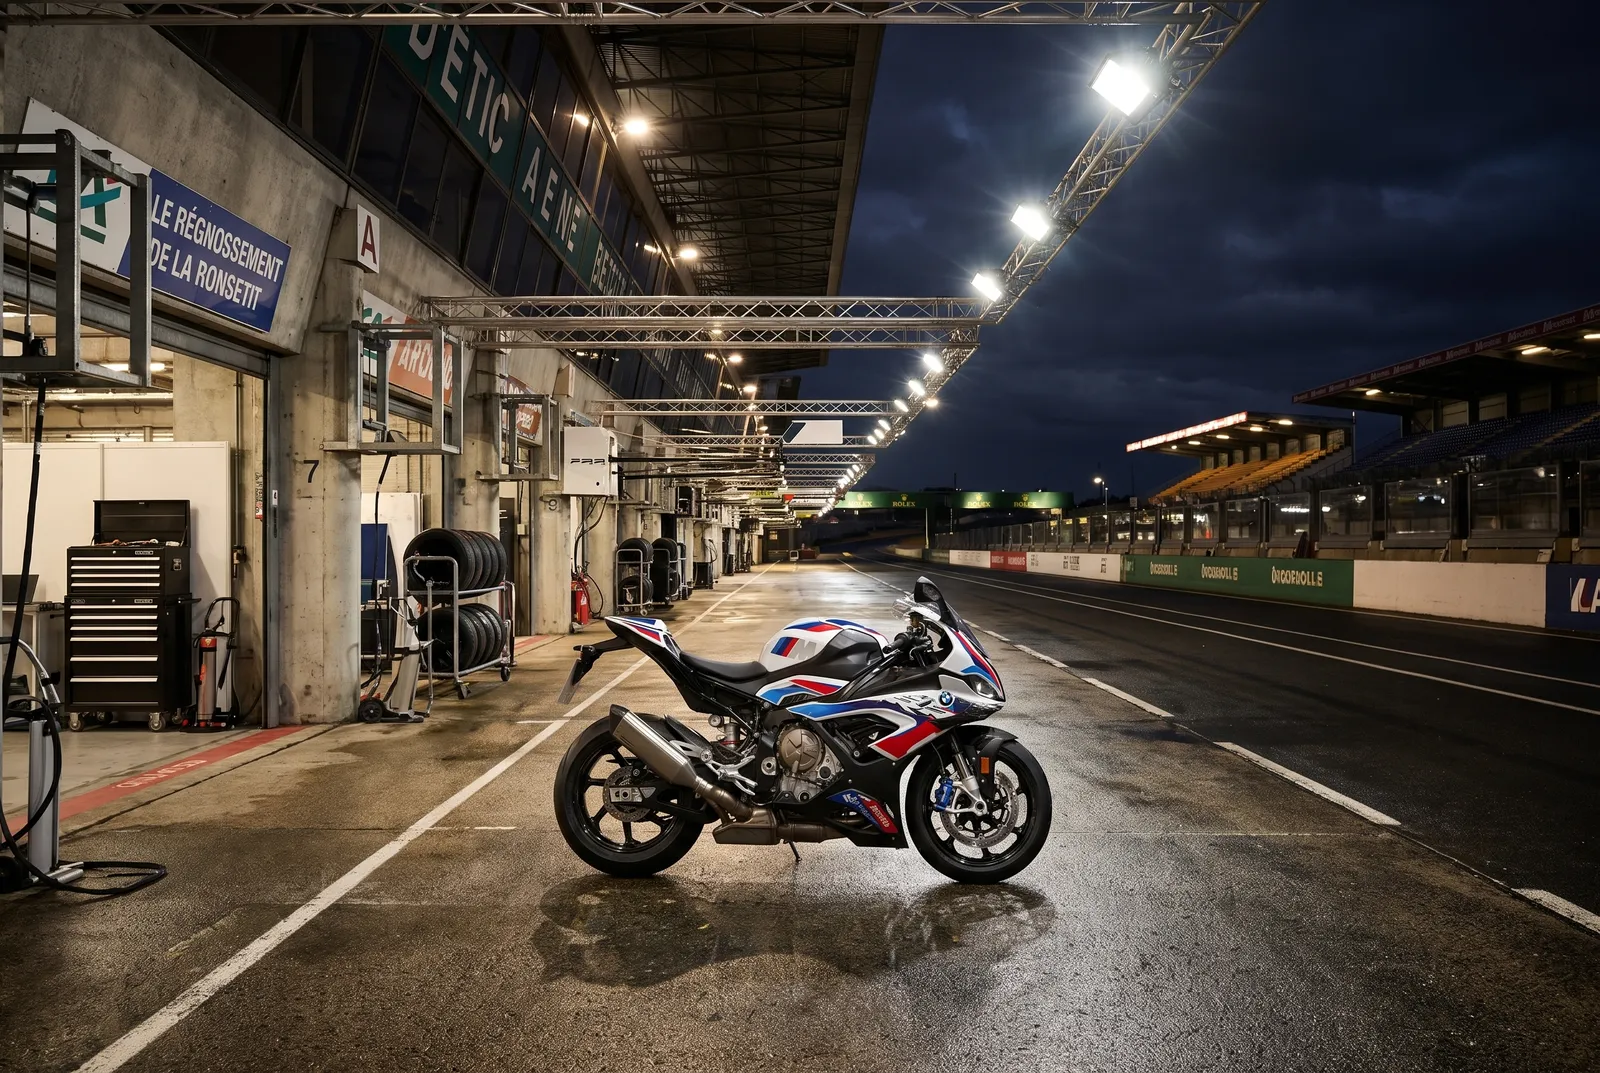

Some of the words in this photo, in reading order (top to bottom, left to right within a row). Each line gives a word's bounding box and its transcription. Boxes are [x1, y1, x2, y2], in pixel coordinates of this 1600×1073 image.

[151, 194, 175, 229] LE
[173, 205, 284, 283] RÉGNOSSEMENT
[360, 214, 378, 266] A
[151, 237, 172, 273] DE
[171, 248, 193, 282] LA
[194, 259, 263, 311] RONSETIT
[303, 459, 320, 484] 7
